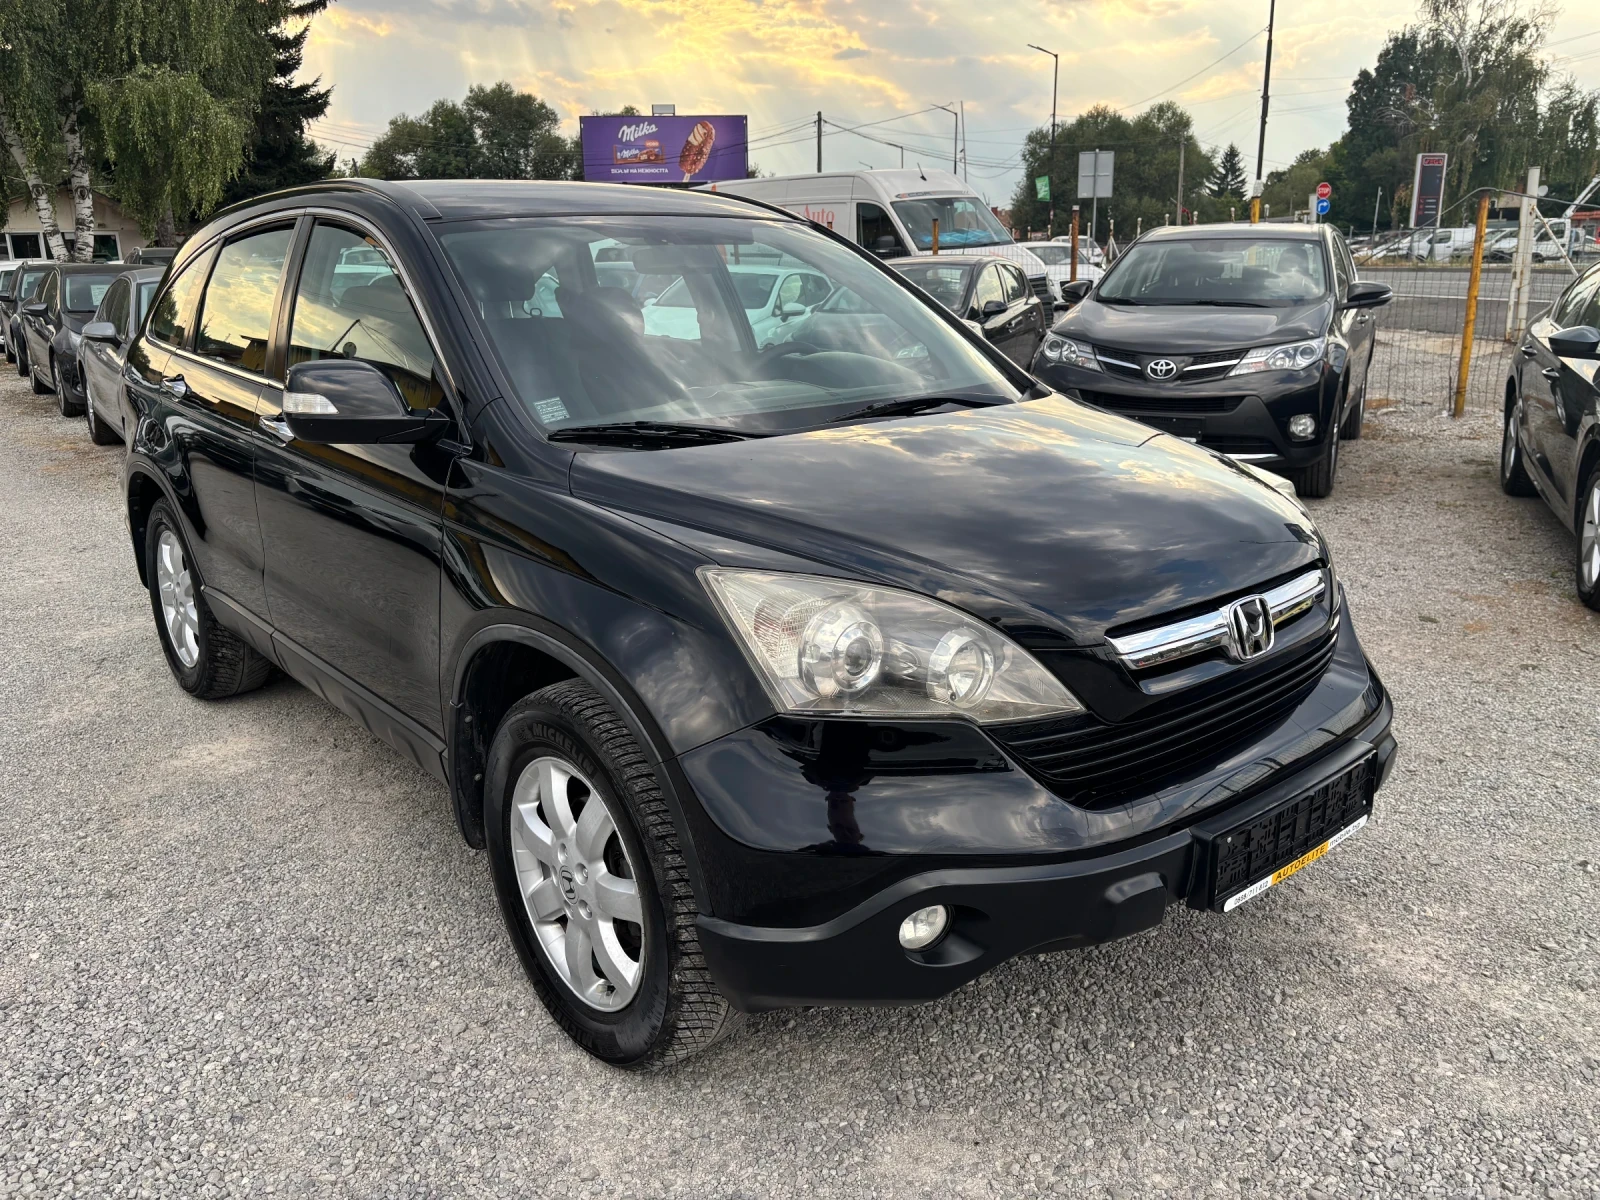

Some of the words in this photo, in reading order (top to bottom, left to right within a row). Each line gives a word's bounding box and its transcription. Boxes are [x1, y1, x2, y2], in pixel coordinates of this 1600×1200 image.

[618, 121, 658, 142] Milka
[803, 204, 835, 224] Auto
[532, 722, 596, 775] MICHELIN
[1275, 845, 1326, 880] AUTOELITE
